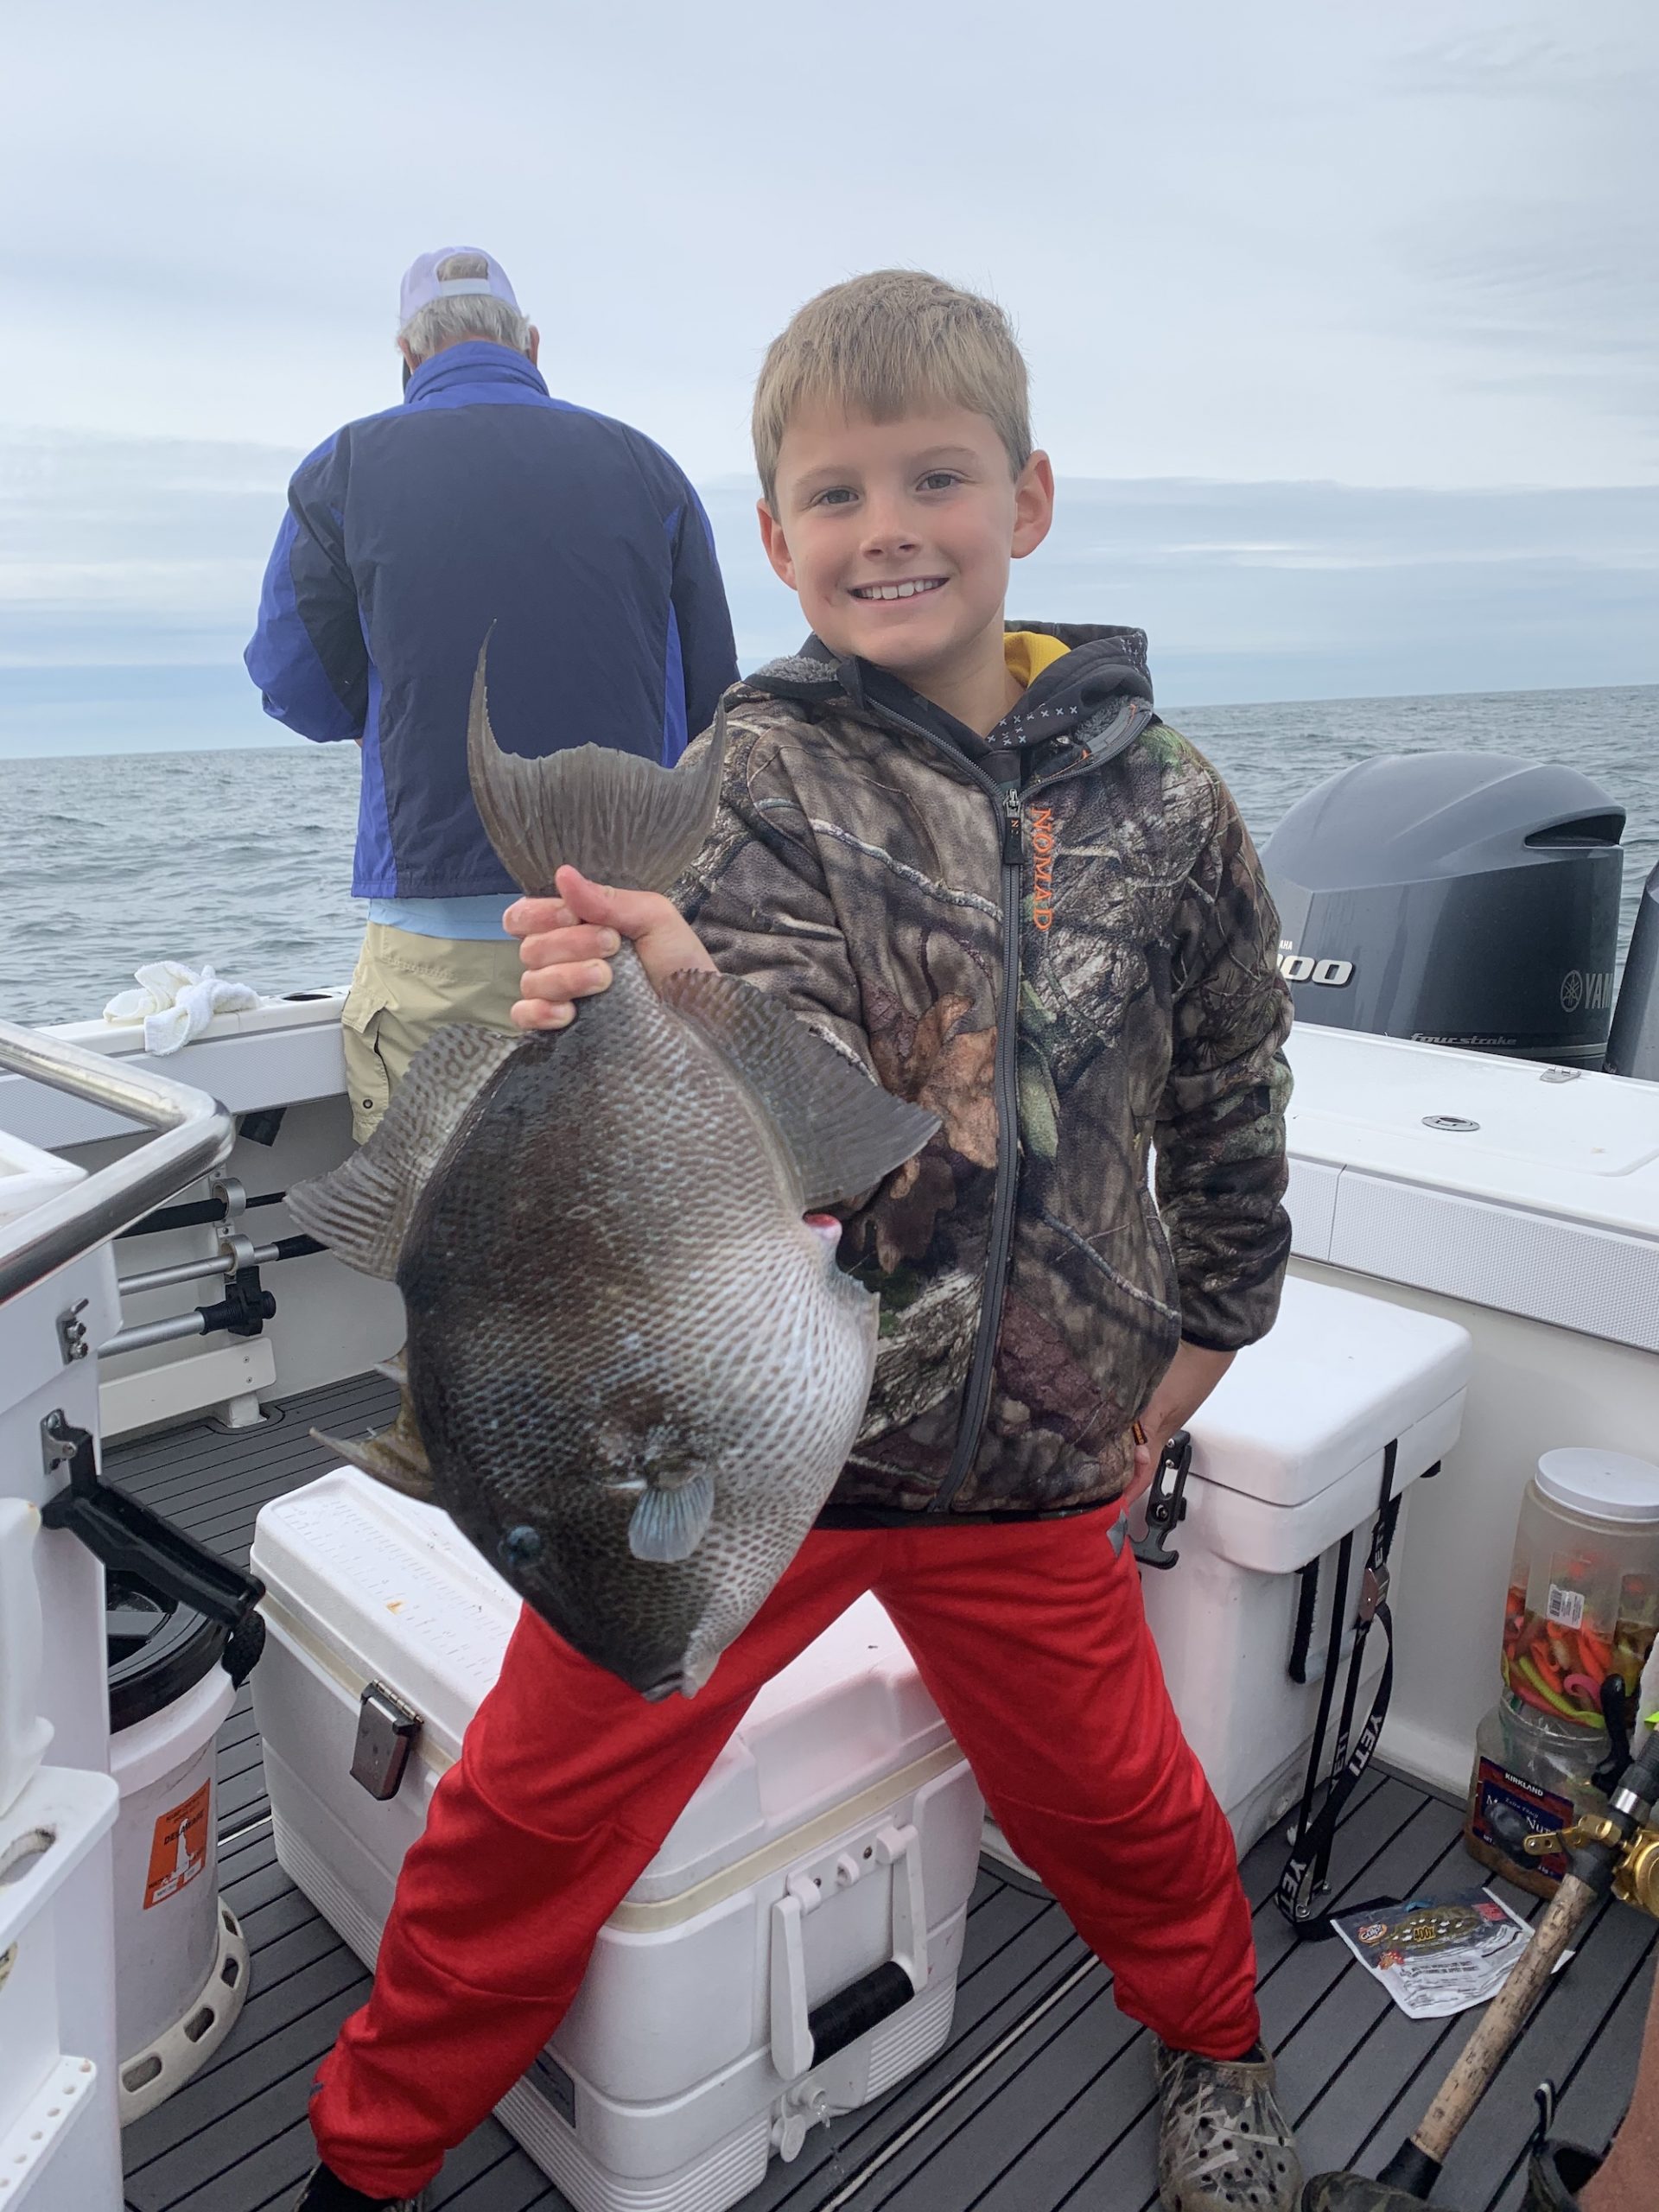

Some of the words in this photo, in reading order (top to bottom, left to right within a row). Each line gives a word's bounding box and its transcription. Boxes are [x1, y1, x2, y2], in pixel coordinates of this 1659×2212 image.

[1031, 806, 1053, 931] NOMAD
[1349, 1714, 1382, 1777] YETI
[1504, 1772, 1544, 1797] KIRKLAND
